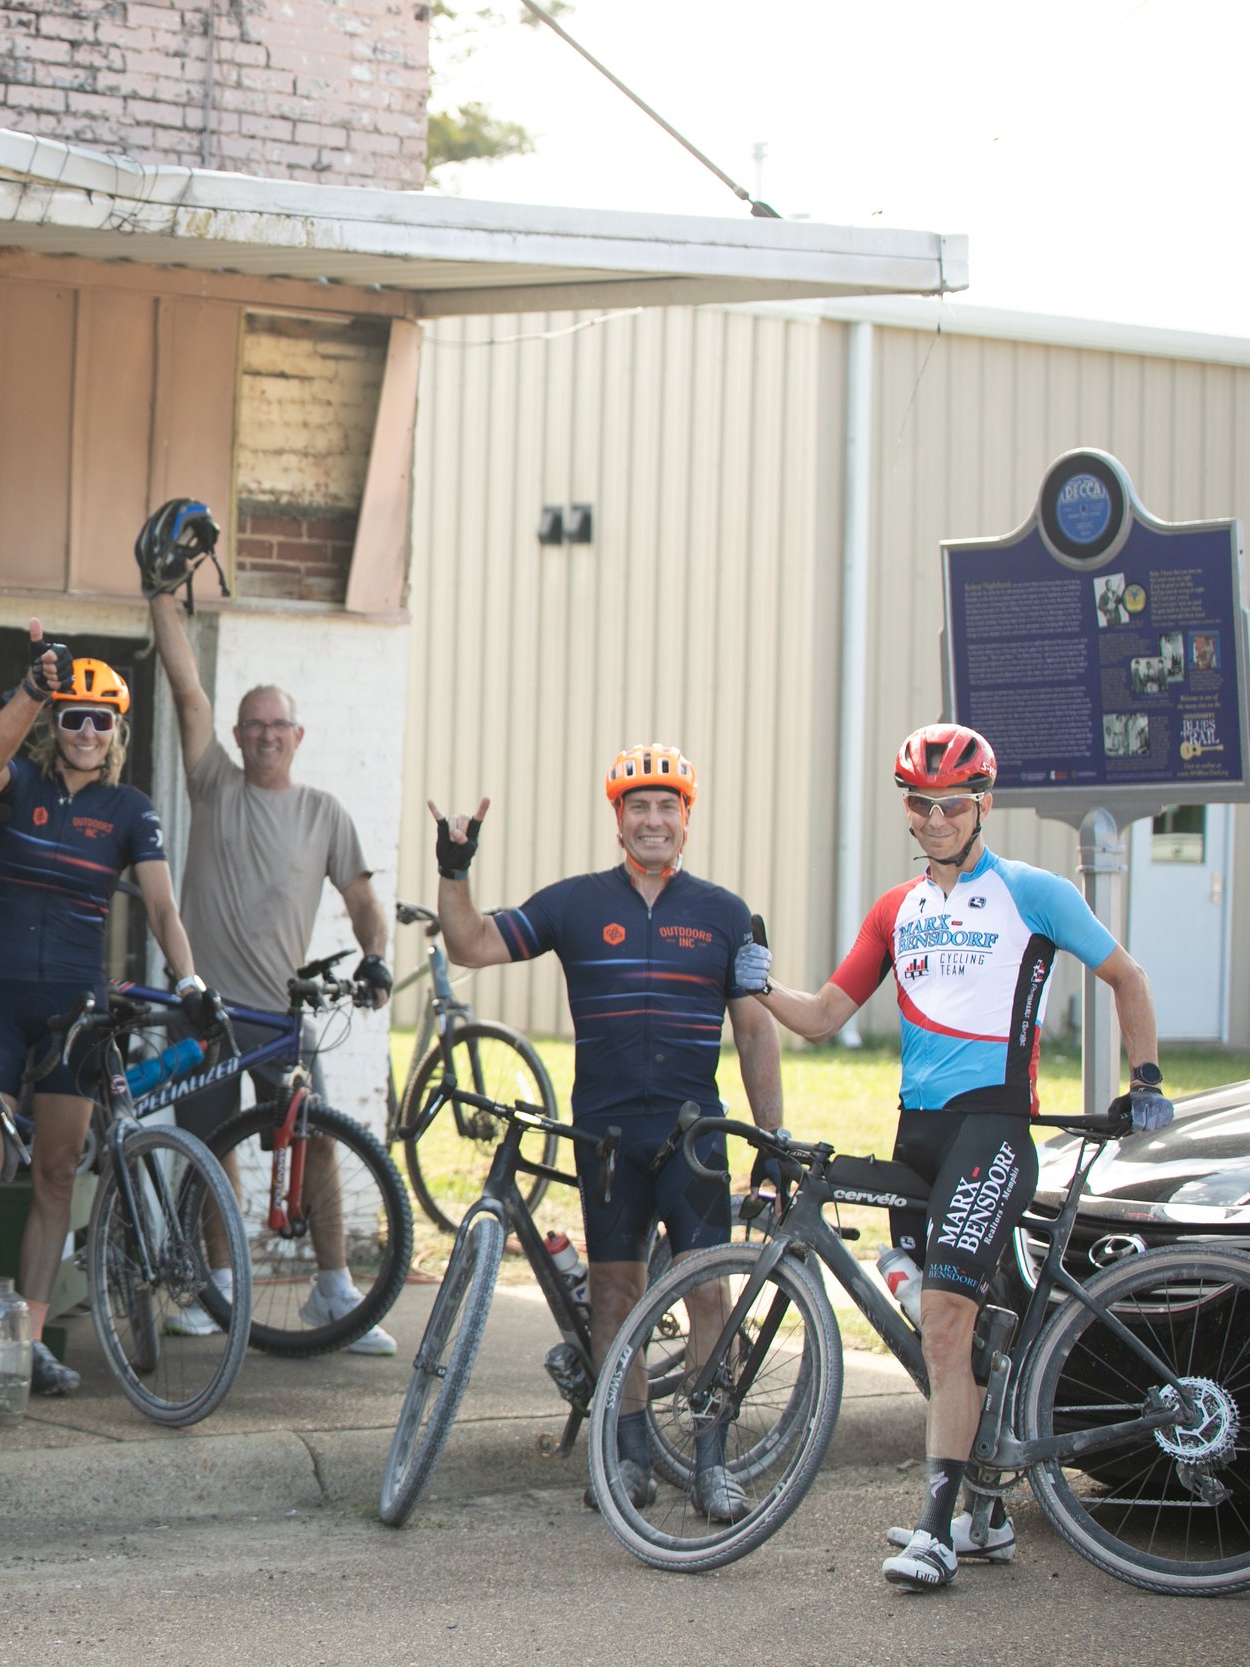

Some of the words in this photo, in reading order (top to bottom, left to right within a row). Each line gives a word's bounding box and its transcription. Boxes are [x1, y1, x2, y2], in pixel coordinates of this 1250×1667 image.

[1065, 481, 1102, 497] DECCA
[1182, 719, 1216, 732] BLUES
[1180, 729, 1220, 745] TRAIL
[659, 926, 712, 944] OUTDOORS
[679, 937, 694, 949] INC
[898, 930, 998, 955] BENSDORF
[940, 953, 985, 965] CYCLING
[941, 965, 965, 976] TEAM
[833, 1188, 907, 1208] cervélo
[957, 1141, 1016, 1255] BENSDORF
[984, 1209, 1004, 1245] Realtors
[1002, 1167, 1020, 1201] Memphis
[928, 1270, 979, 1289] BENSDORF
[620, 1344, 633, 1368] DT
[605, 1368, 623, 1410] SWISS
